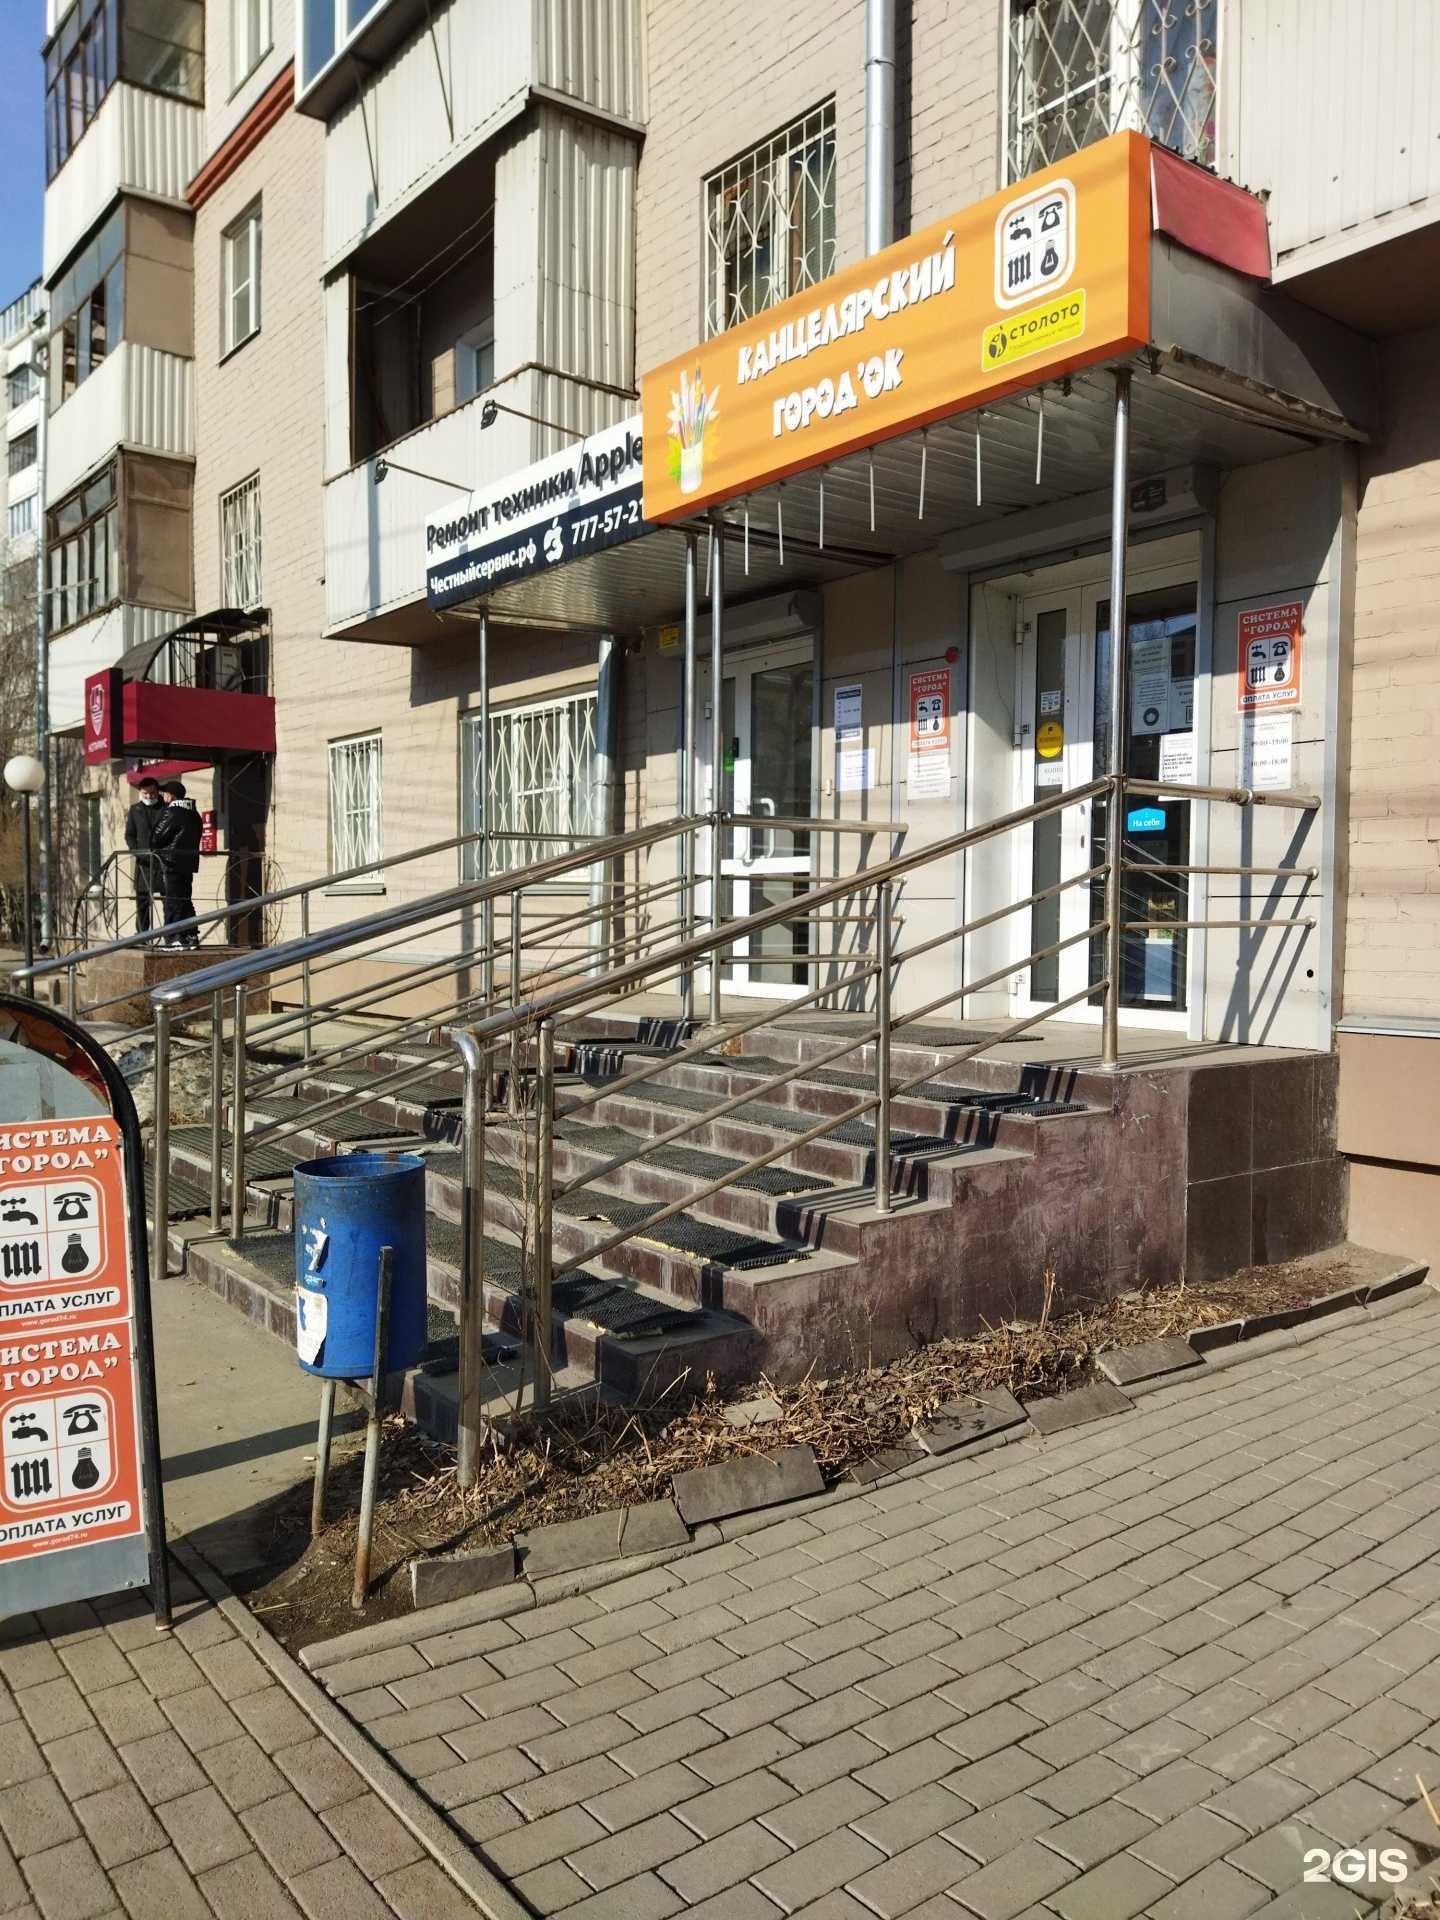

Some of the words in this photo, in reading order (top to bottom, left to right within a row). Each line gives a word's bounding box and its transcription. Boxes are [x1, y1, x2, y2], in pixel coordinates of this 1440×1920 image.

[737, 230, 956, 384] КАНЦЕЛЯРСКИЙ
[1009, 303, 1080, 340] СТОЛОТО
[427, 506, 491, 552] Ремонт
[491, 467, 575, 522] техники
[579, 431, 643, 491] Apple
[430, 537, 537, 594] Честныйсервис.рф
[571, 497, 643, 545] 777-57-2
[1242, 607, 1298, 625] СИСТЕМА
[61, 1290, 115, 1309] УСЛУГ
[0, 1332, 122, 1366] ИСТЕМА
[72, 1505, 125, 1527] УСЛУГ
